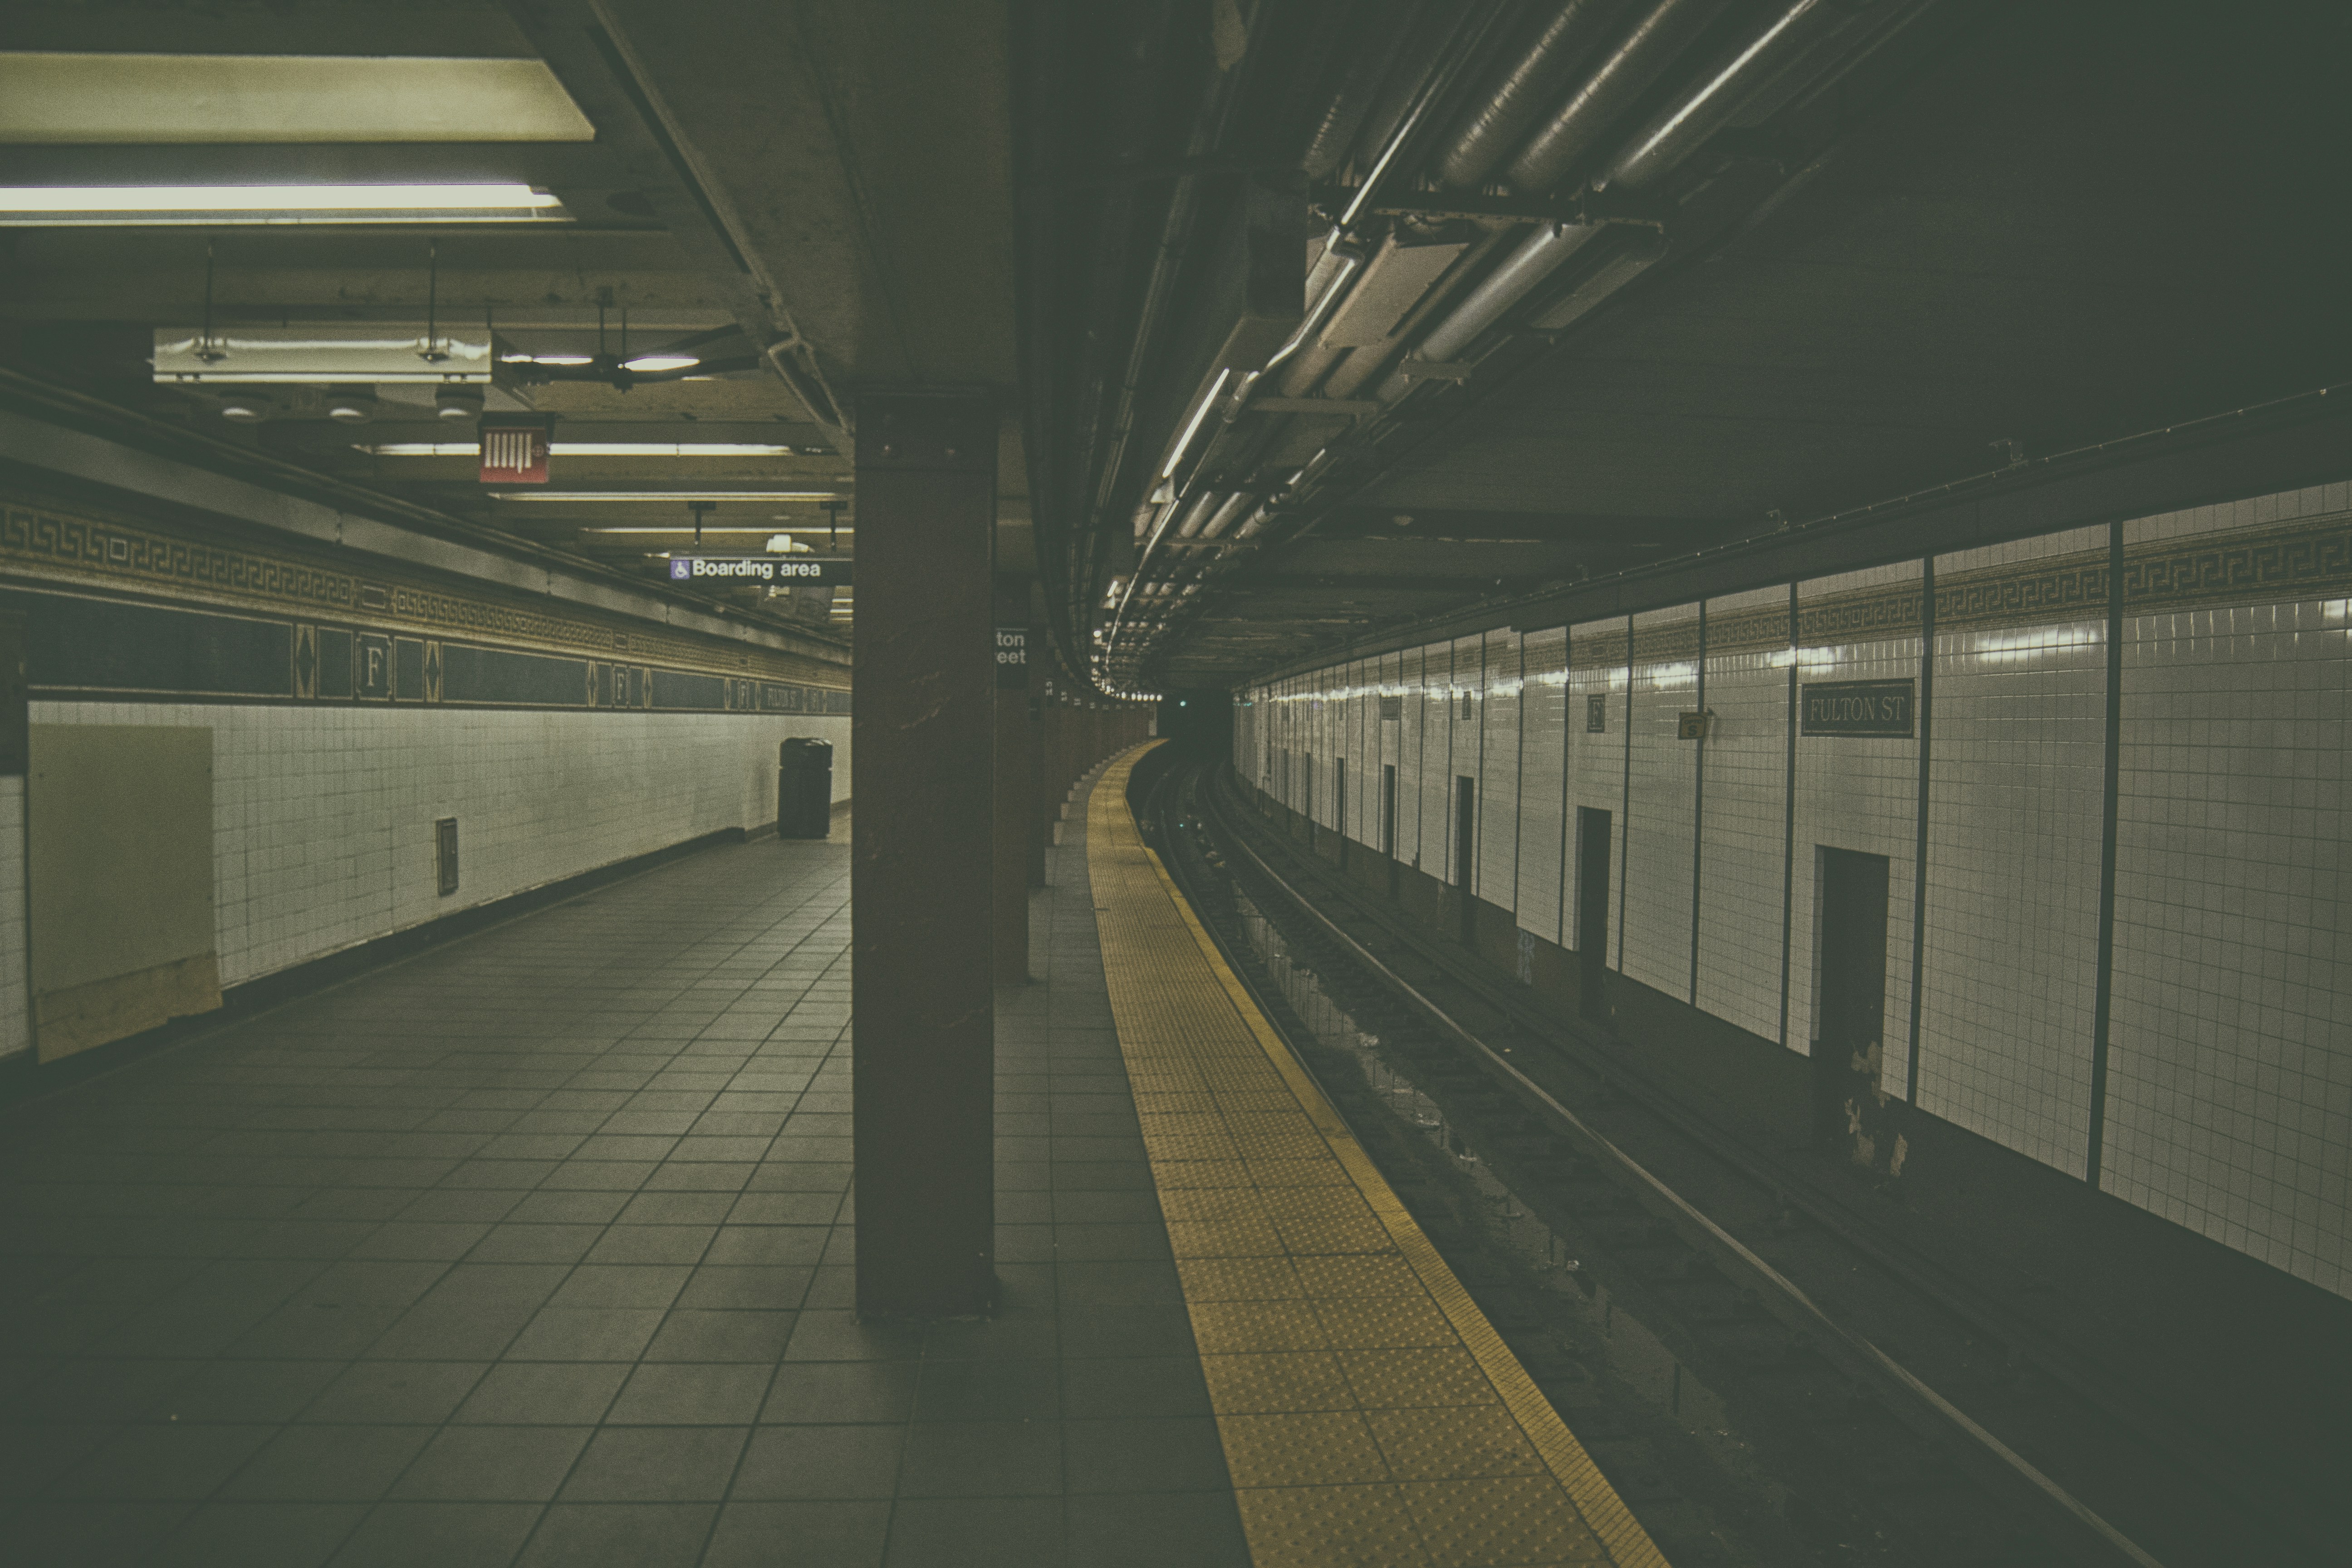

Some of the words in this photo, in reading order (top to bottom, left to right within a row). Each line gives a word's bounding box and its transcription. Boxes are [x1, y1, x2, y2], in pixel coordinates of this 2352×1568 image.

[692, 559, 774, 579] Boarding
[780, 563, 821, 577] area
[995, 631, 1025, 647] ton
[367, 646, 383, 687] F
[994, 648, 1027, 665] eet
[617, 672, 625, 700] F
[1592, 701, 1600, 725] F
[1810, 697, 1876, 721] FULTON
[1882, 696, 1905, 721] ST
[1687, 725, 1697, 736] S
